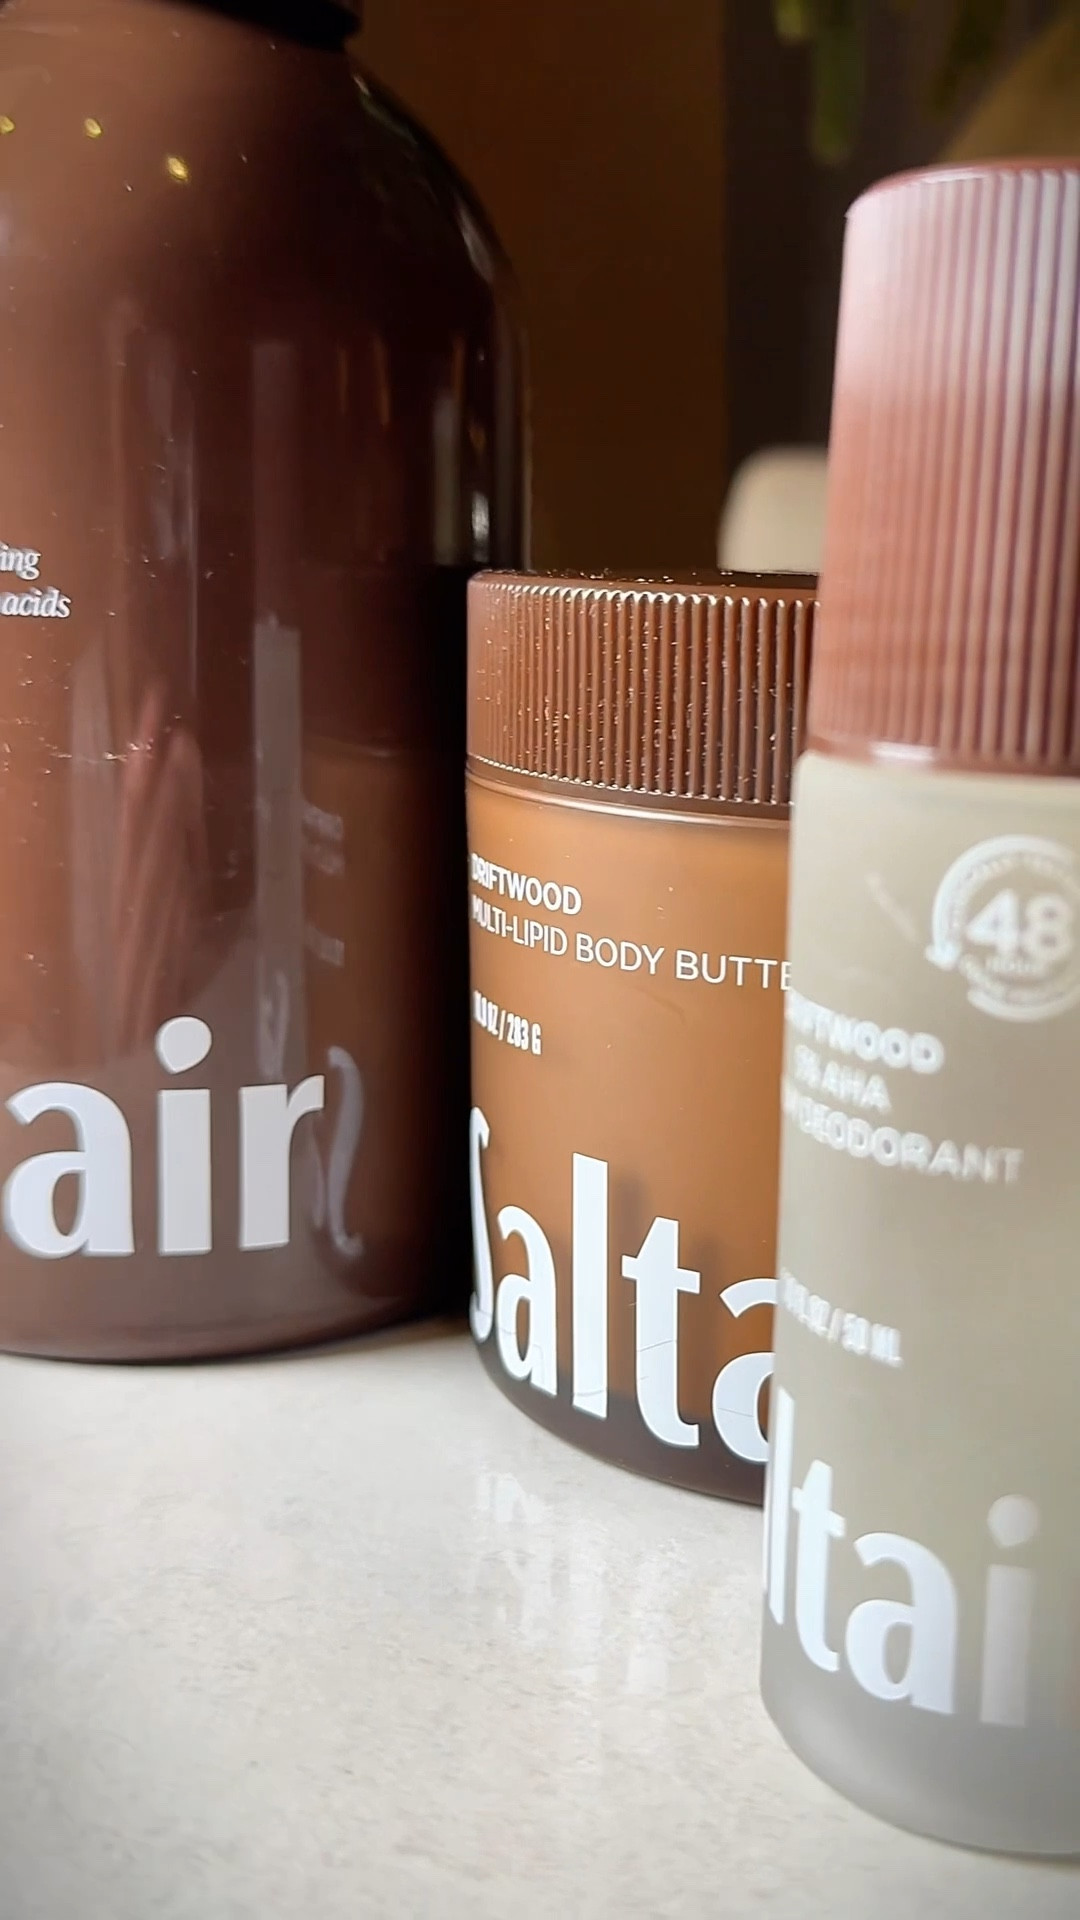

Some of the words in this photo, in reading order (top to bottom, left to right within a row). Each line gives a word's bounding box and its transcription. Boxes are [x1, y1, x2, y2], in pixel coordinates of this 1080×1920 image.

[0, 586, 72, 618] acids
[471, 853, 582, 915] DRIFTWOOD
[472, 894, 568, 956] MULTI-LIPID
[576, 932, 665, 975] BODY
[676, 949, 792, 991] BUTTE
[966, 886, 1074, 974] 48
[506, 1013, 529, 1051] 283
[532, 1023, 542, 1055] G
[2, 1016, 325, 1258] air
[763, 1386, 1040, 1728] ltai
